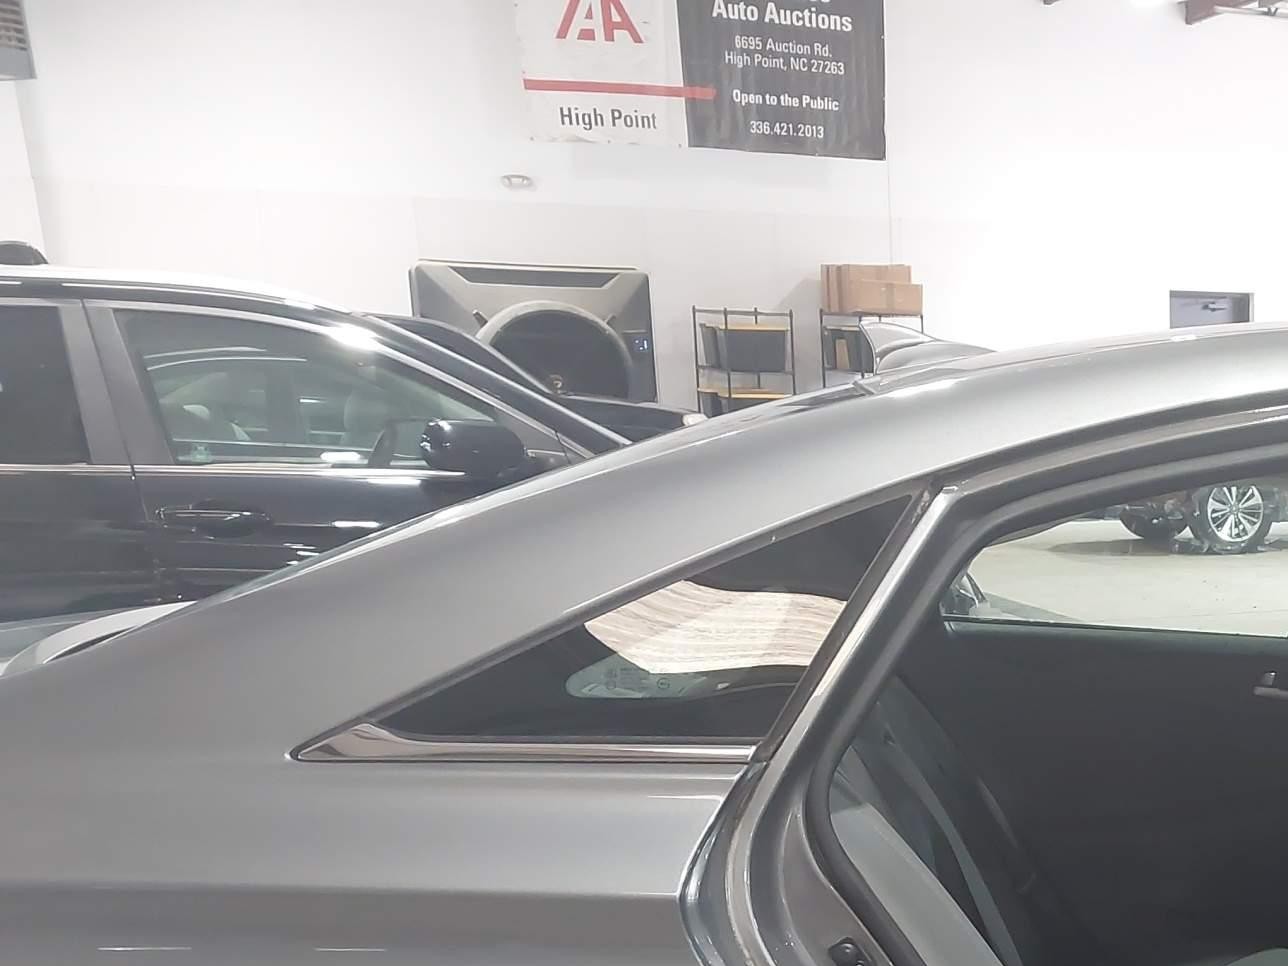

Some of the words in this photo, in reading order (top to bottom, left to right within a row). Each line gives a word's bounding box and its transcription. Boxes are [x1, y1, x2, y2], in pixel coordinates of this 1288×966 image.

[712, 0, 759, 21] Auto
[764, 2, 853, 32] Auctions
[734, 35, 763, 50] 6695
[766, 38, 811, 55] Auction
[814, 43, 833, 58] Rd.
[725, 51, 751, 68] High
[754, 54, 787, 71] Point,
[790, 57, 809, 72] NC
[811, 60, 845, 75] 27263
[732, 89, 762, 106] Open
[766, 94, 778, 106] to
[780, 94, 799, 107] the
[802, 95, 840, 111] Public
[559, 107, 605, 131] High
[610, 108, 657, 129] Point
[750, 120, 825, 138] 336.421.2013
